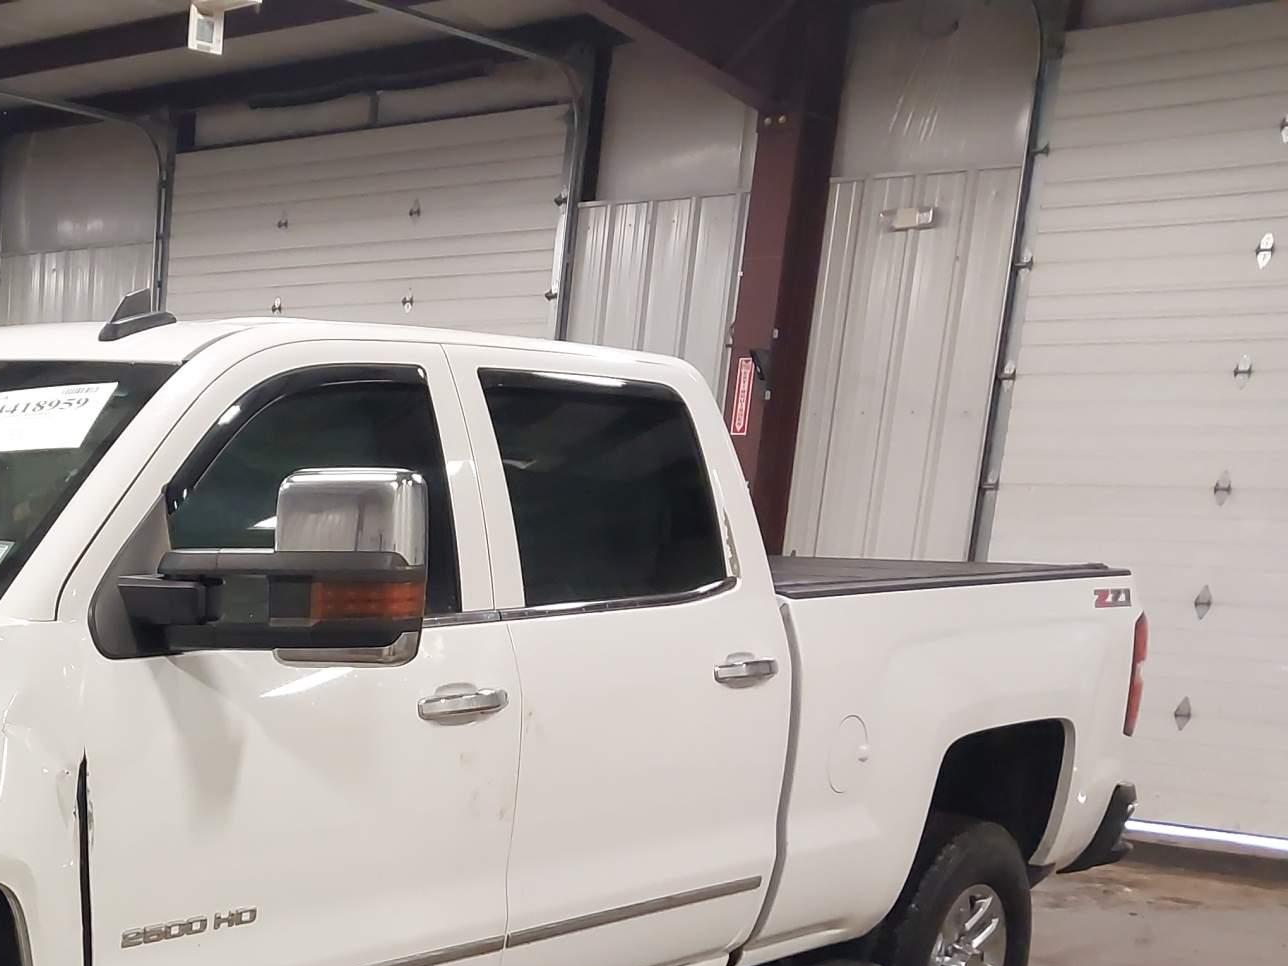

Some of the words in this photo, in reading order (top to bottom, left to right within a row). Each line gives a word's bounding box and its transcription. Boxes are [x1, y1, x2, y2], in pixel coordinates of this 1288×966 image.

[1094, 589, 1132, 608] Z71
[121, 915, 208, 949] 2500
[213, 906, 257, 930] HD
